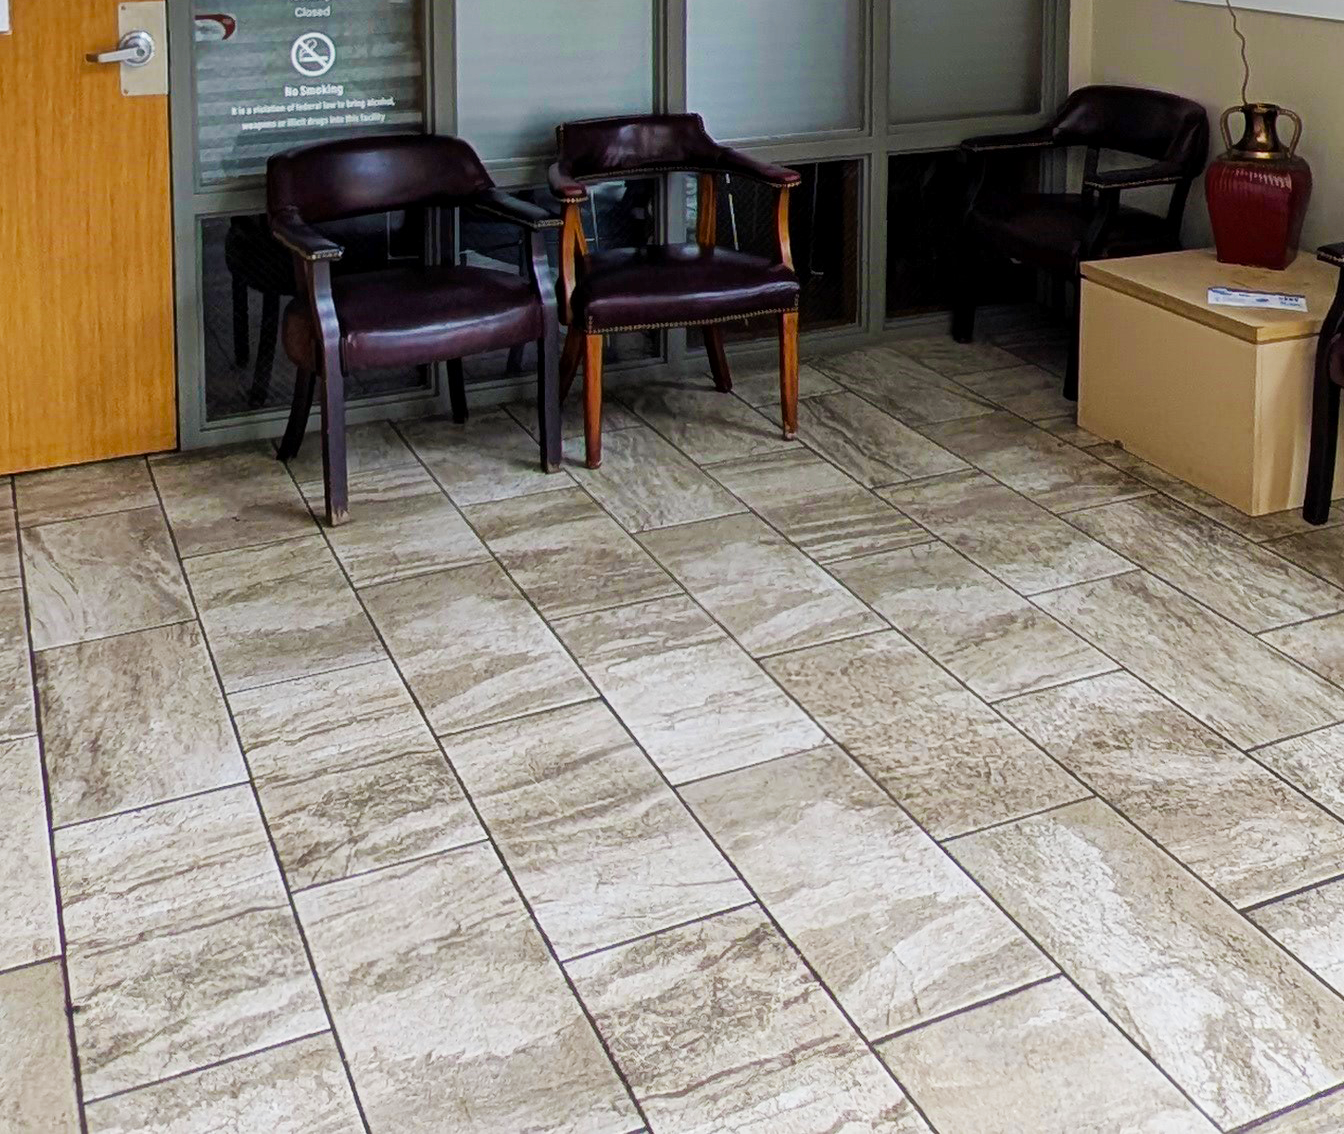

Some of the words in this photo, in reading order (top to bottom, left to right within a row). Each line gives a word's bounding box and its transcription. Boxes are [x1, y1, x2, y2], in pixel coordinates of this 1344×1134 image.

[295, 6, 331, 17] Closed
[284, 86, 299, 97] No
[300, 84, 344, 97] Smoking
